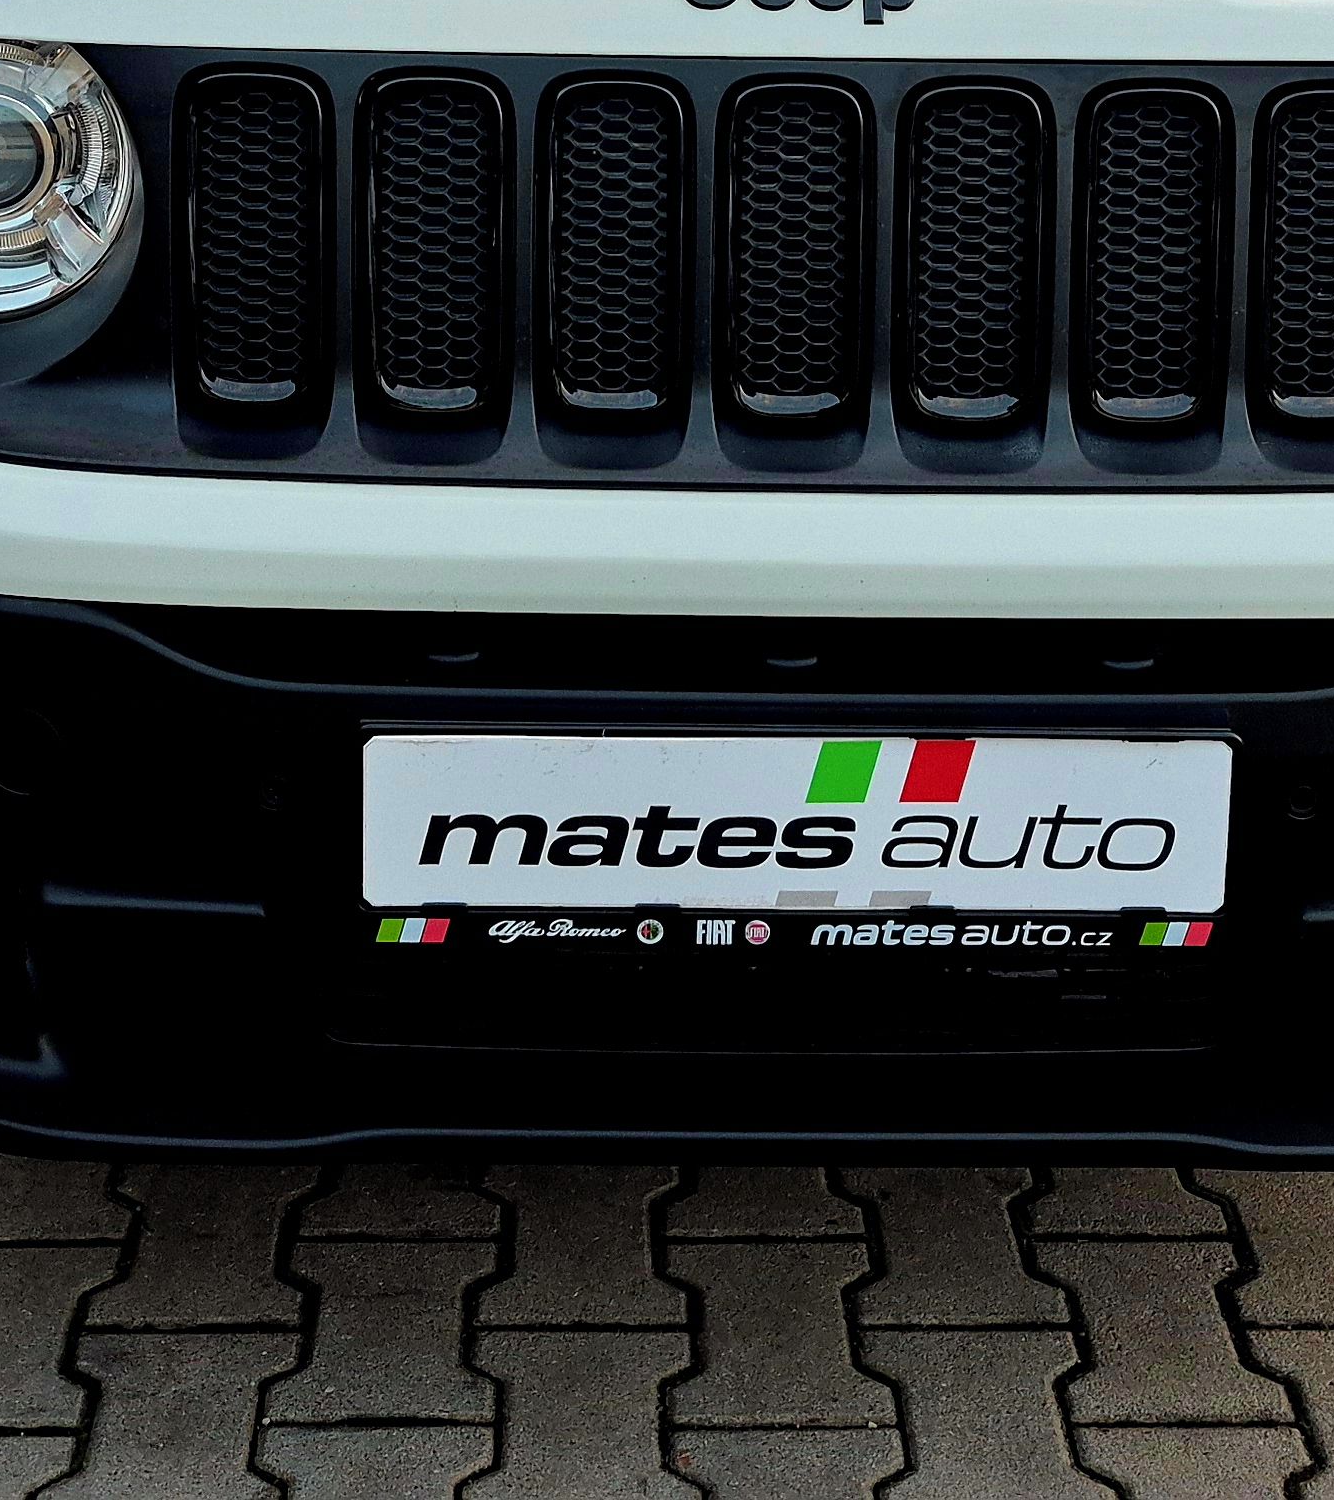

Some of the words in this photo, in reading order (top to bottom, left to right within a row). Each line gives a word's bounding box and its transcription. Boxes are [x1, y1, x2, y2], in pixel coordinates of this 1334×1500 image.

[418, 804, 857, 870] mates
[880, 803, 1177, 872] auto
[488, 920, 545, 943] Alfa
[546, 918, 627, 937] Romeo
[696, 919, 736, 945] FIAT
